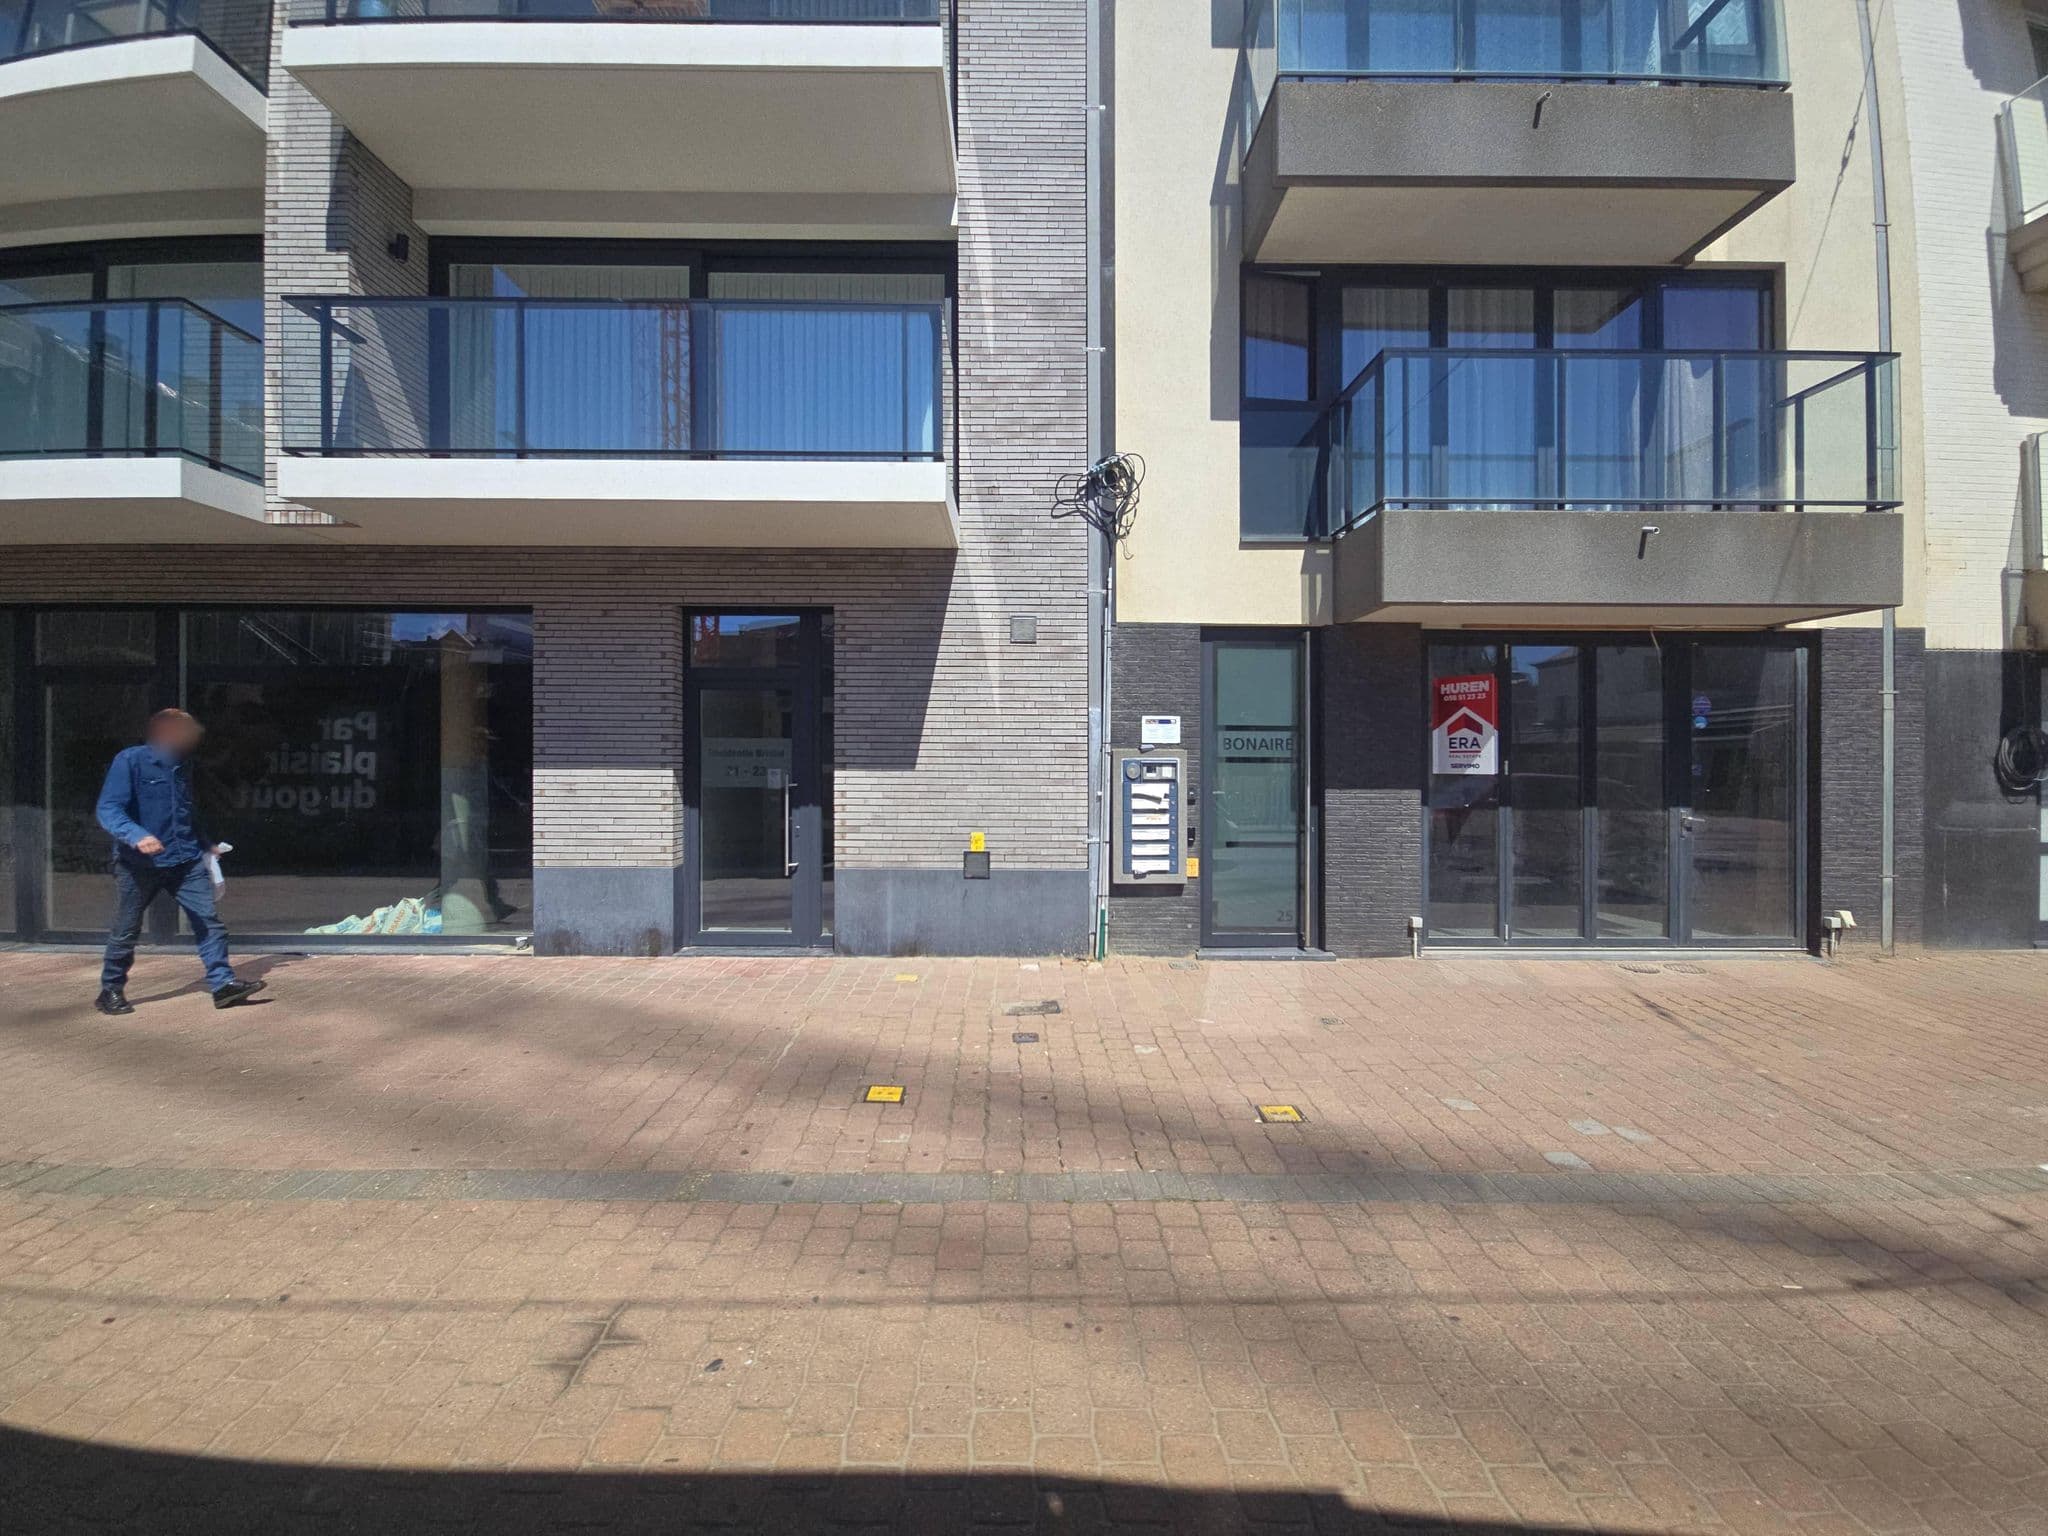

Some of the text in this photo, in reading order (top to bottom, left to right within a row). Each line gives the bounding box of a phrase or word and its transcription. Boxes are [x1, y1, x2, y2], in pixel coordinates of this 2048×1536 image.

[1440, 680, 1490, 694] HUREN
[1224, 737, 1294, 751] BONAIRE
[1448, 737, 1481, 749] ERA
